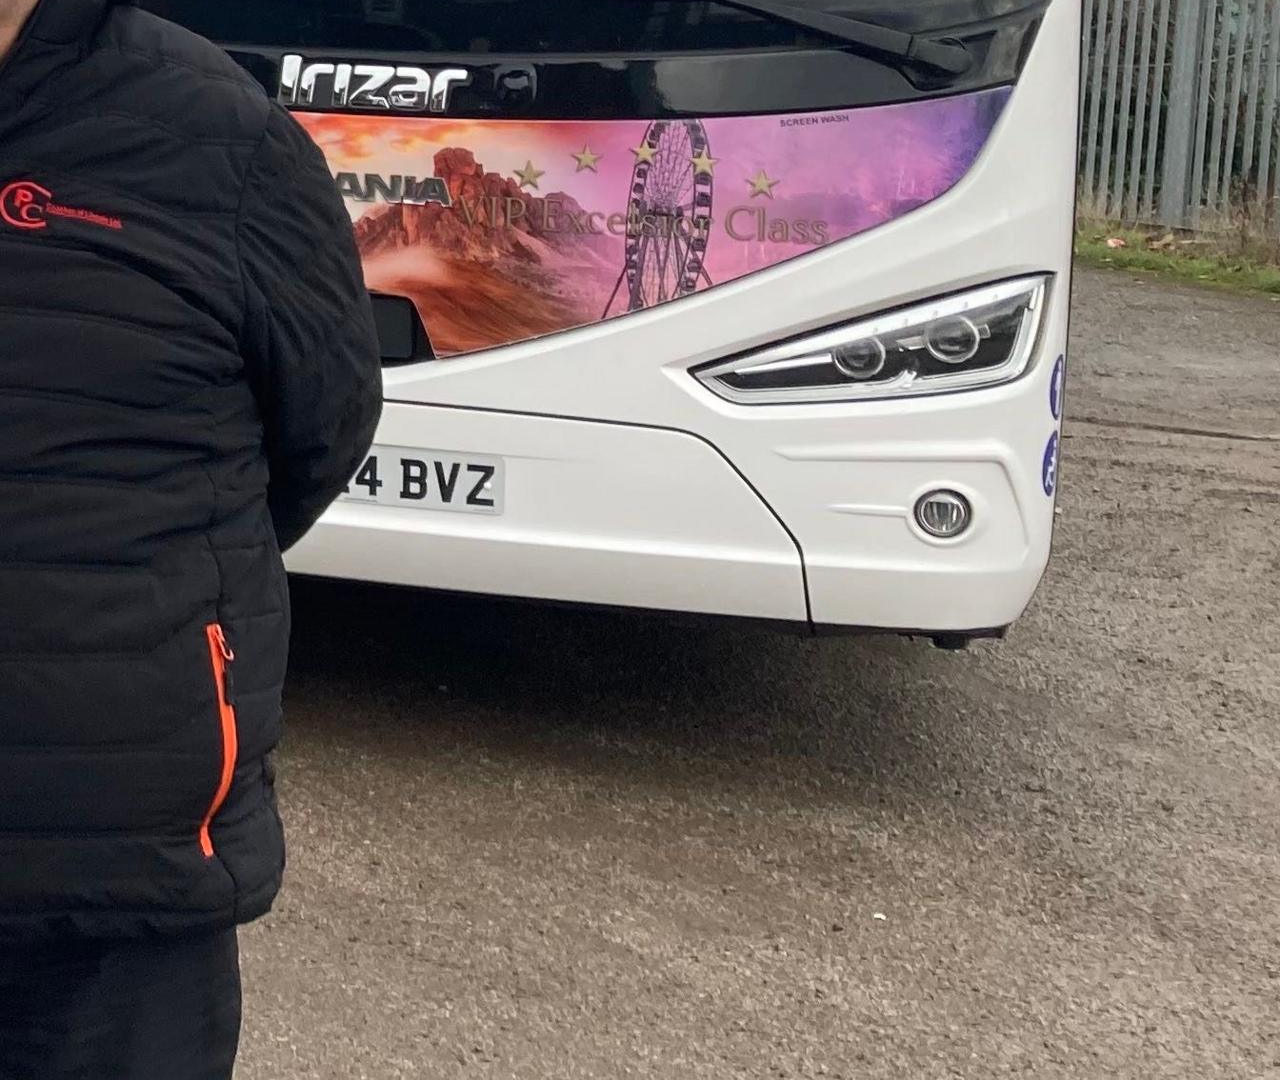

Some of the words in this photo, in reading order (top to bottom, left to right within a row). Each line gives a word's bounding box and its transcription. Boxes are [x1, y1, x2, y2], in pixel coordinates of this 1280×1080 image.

[278, 54, 469, 112] Irizar
[780, 117, 818, 127] SCREEN
[821, 114, 849, 123] WASH
[335, 172, 453, 207] ANIA
[459, 195, 527, 228] VIP
[542, 197, 713, 238] Excelsior
[725, 204, 831, 246] Class
[400, 457, 495, 507] BVZ
